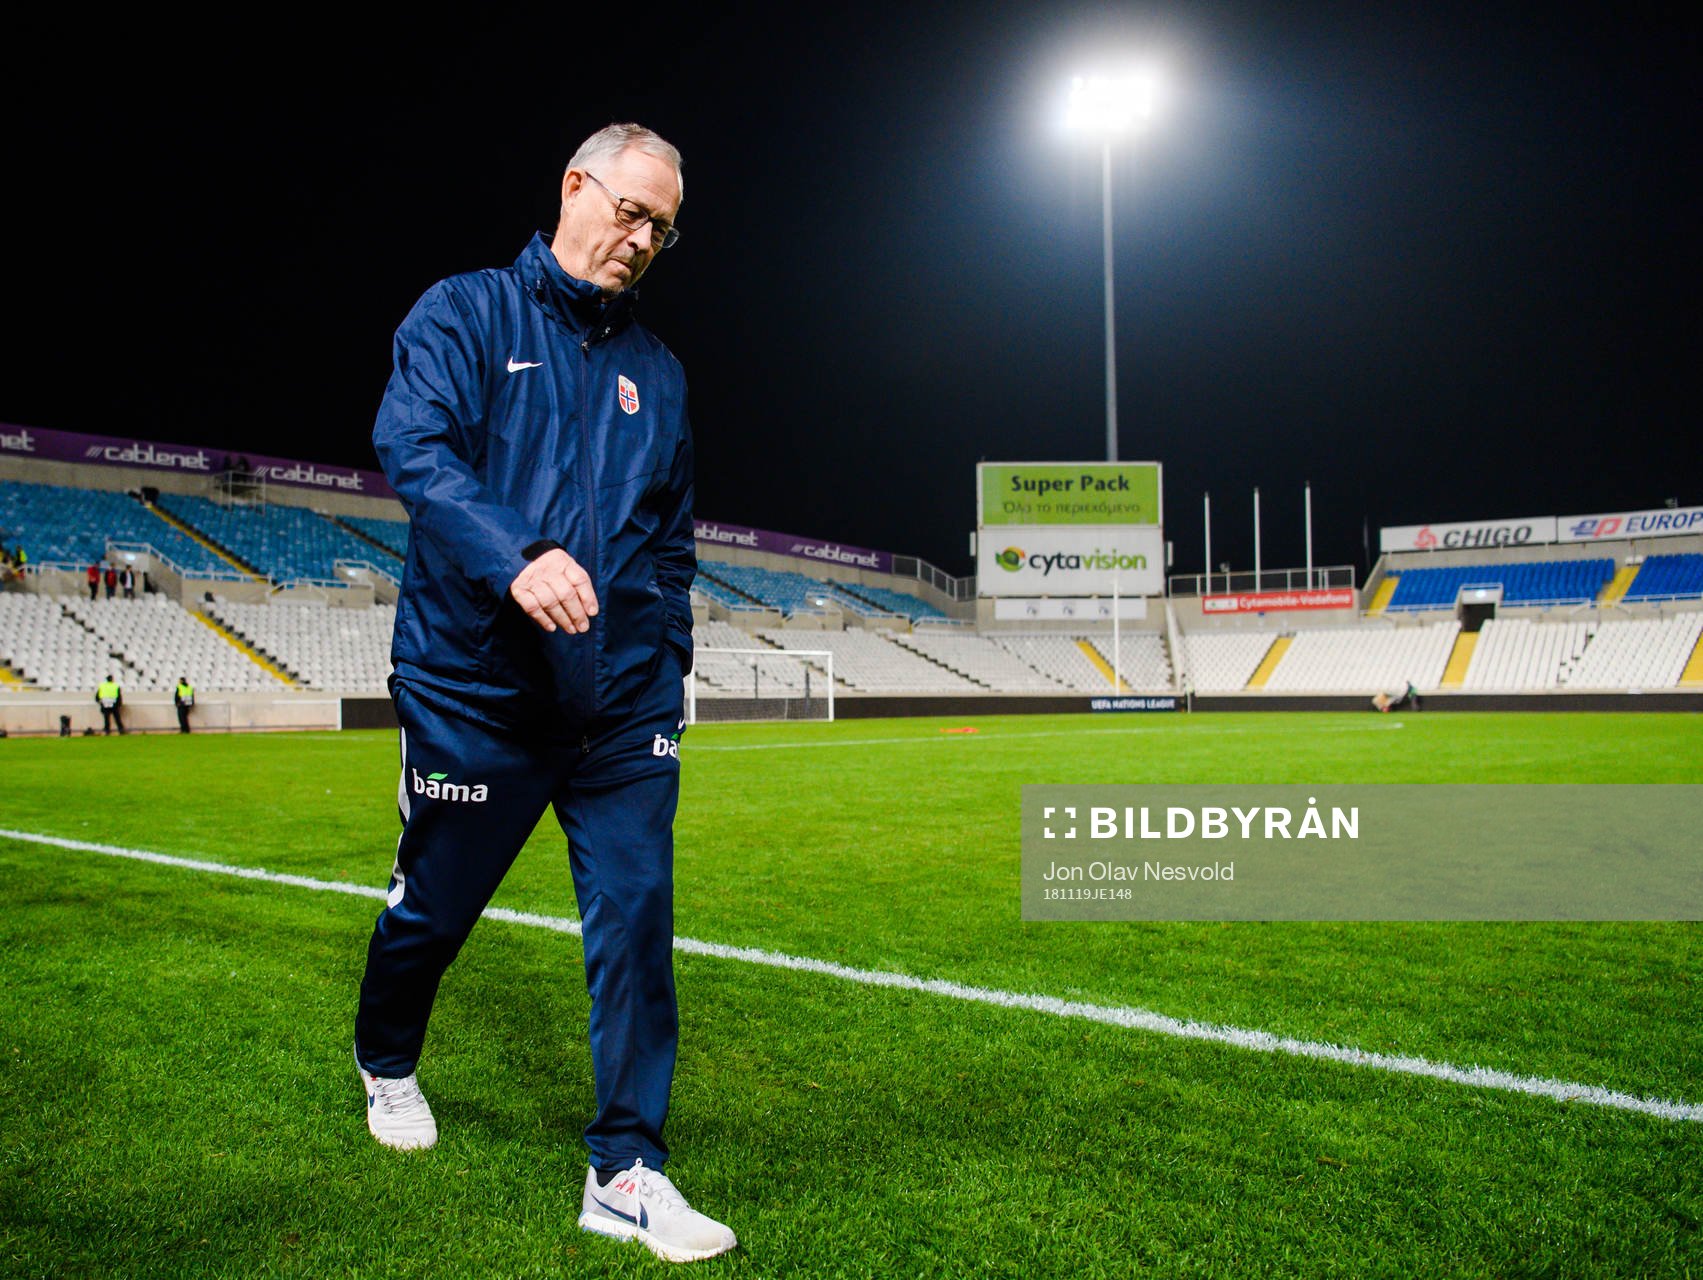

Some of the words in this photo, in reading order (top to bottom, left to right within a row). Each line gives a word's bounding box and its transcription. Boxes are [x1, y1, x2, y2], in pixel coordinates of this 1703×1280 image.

[104, 443, 210, 470] cablenet
[270, 464, 363, 490] cablenet
[1011, 475, 1074, 496] Super
[1081, 474, 1130, 491] Pack
[694, 524, 758, 546] ablenet
[1443, 526, 1532, 549] CHIGO
[804, 544, 880, 568] cablenet
[1029, 548, 1147, 576] cytavision
[1091, 699, 1111, 709] UEFA
[1113, 699, 1145, 709] NATIONS
[1147, 699, 1175, 709] LEAGUE
[653, 734, 680, 759] ba
[412, 768, 488, 802] bama
